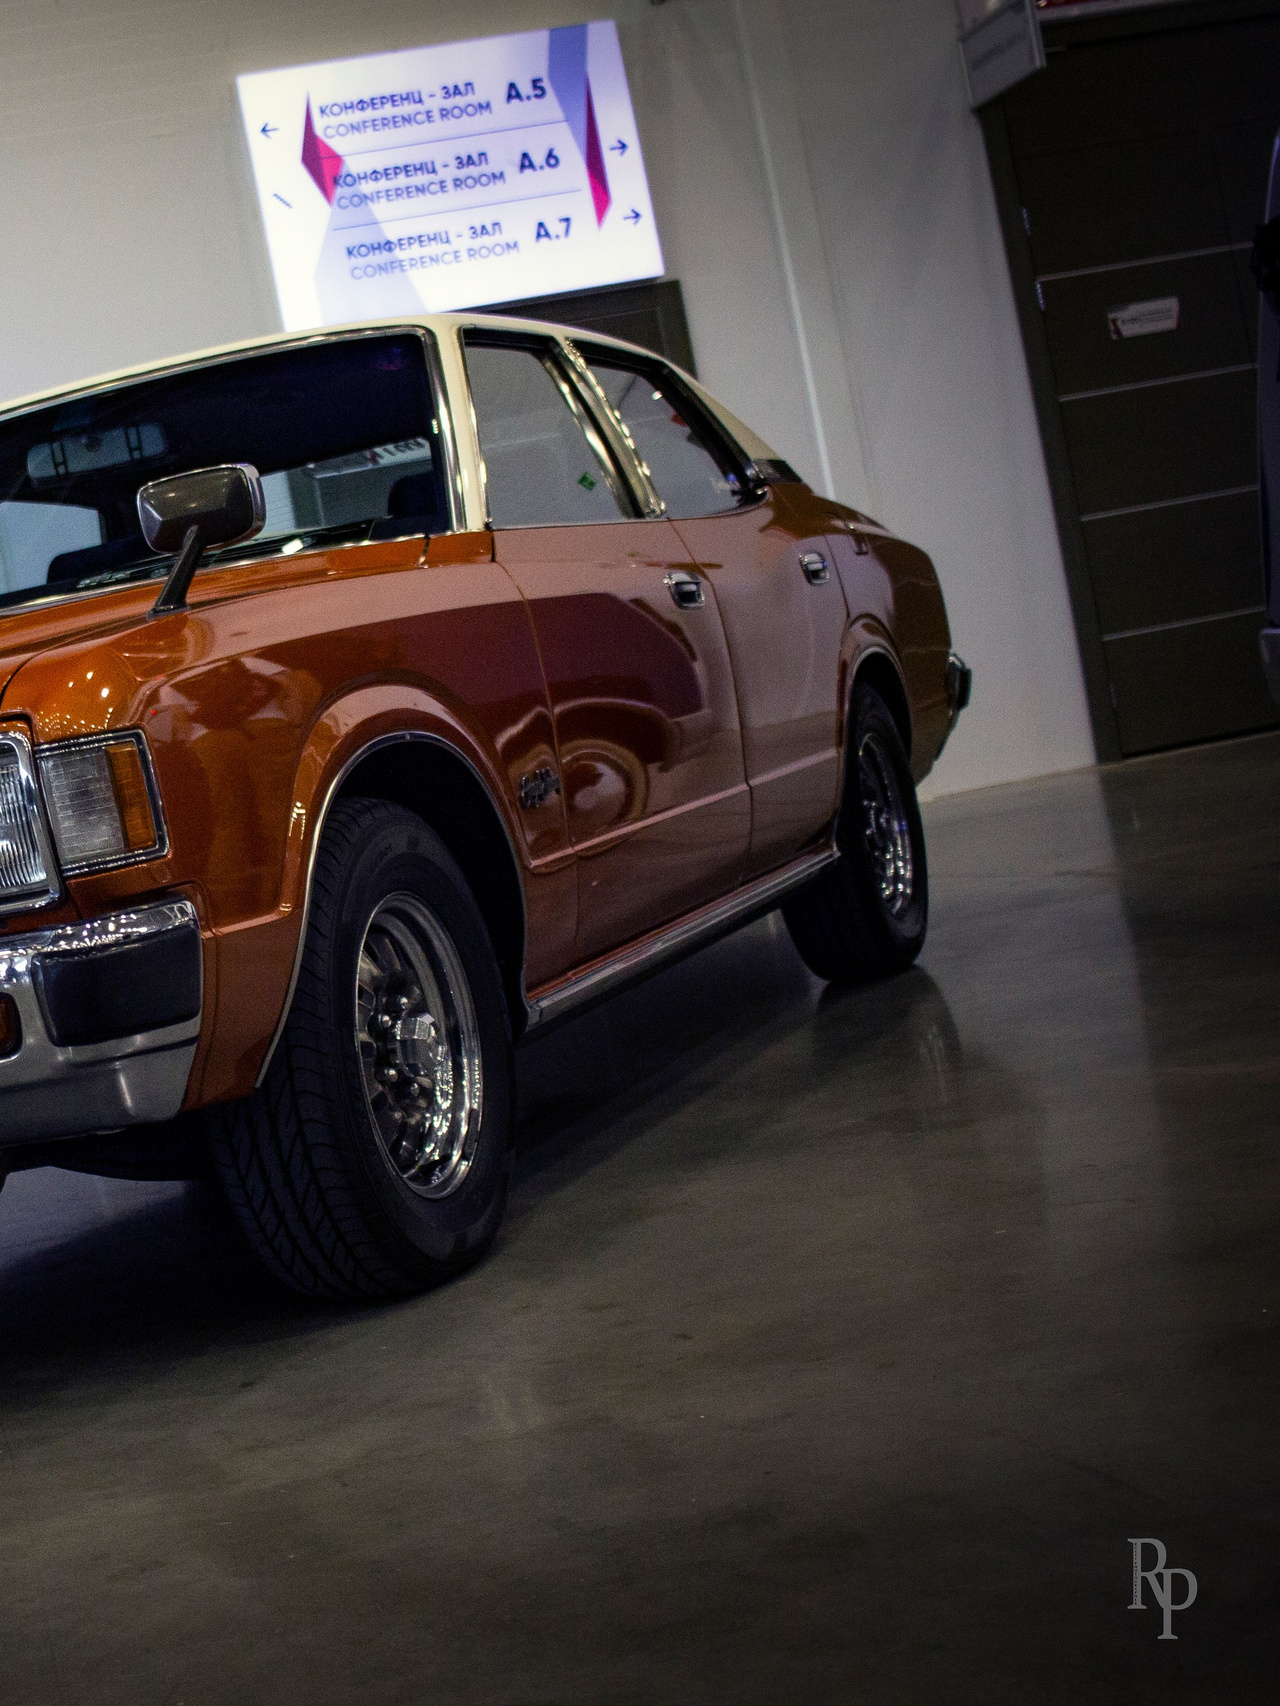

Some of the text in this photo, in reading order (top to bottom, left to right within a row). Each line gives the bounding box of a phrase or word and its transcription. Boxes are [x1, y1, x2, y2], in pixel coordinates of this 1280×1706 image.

[319, 90, 424, 118] КОНФЕРЕНЦ
[441, 82, 475, 99] ЗАЛ
[506, 77, 547, 104] A.5
[323, 101, 492, 138] CONFERENCE ROOM
[333, 160, 438, 188] КОНФЕРЕНЦ
[455, 152, 489, 170] ЗАЛ
[519, 147, 560, 174] A.6
[337, 170, 506, 210] CONFERENCE ROOM
[345, 230, 451, 260] КОНФЕРЕНЦ
[469, 222, 503, 240] ЗАЛ
[535, 217, 572, 243] A.7
[351, 241, 520, 280] CONFERENCE ROOM
